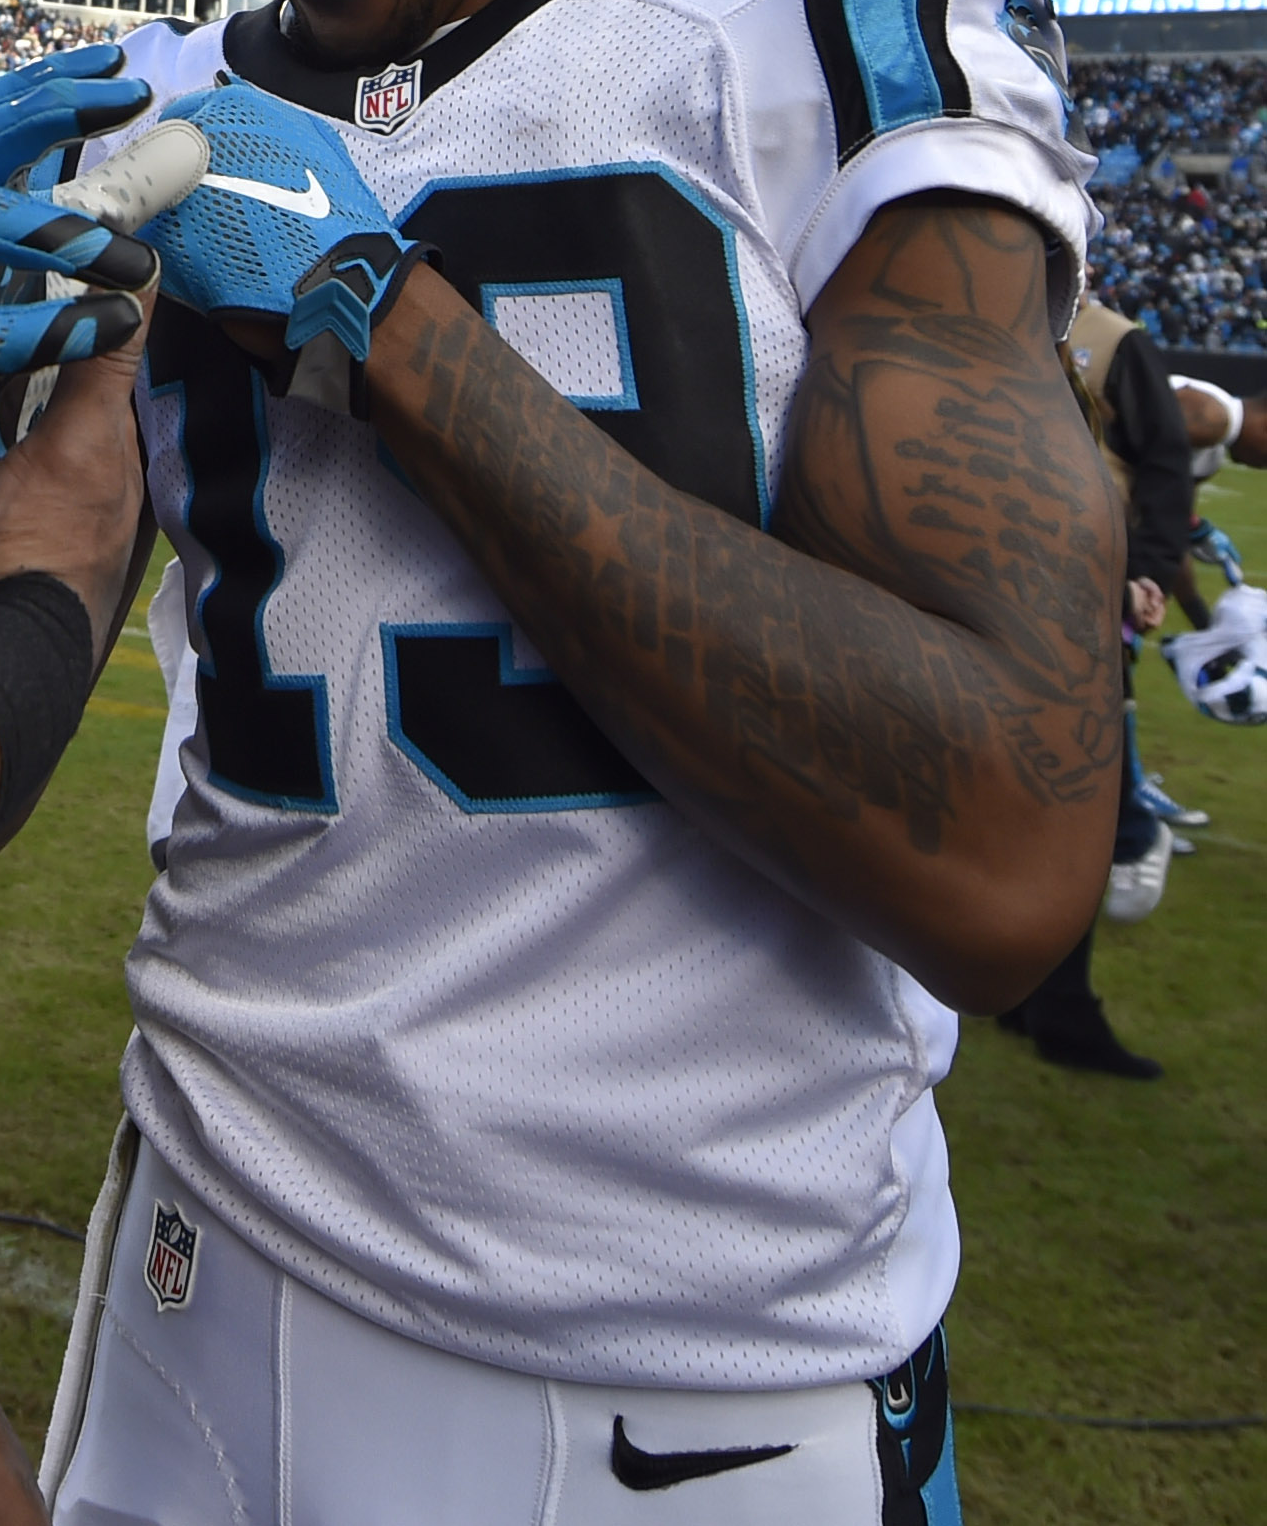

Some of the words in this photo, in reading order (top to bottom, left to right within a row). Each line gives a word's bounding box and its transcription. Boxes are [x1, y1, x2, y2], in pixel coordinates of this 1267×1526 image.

[364, 85, 409, 119] NFL
[143, 159, 773, 814] 19
[151, 1241, 184, 1296] NFL
